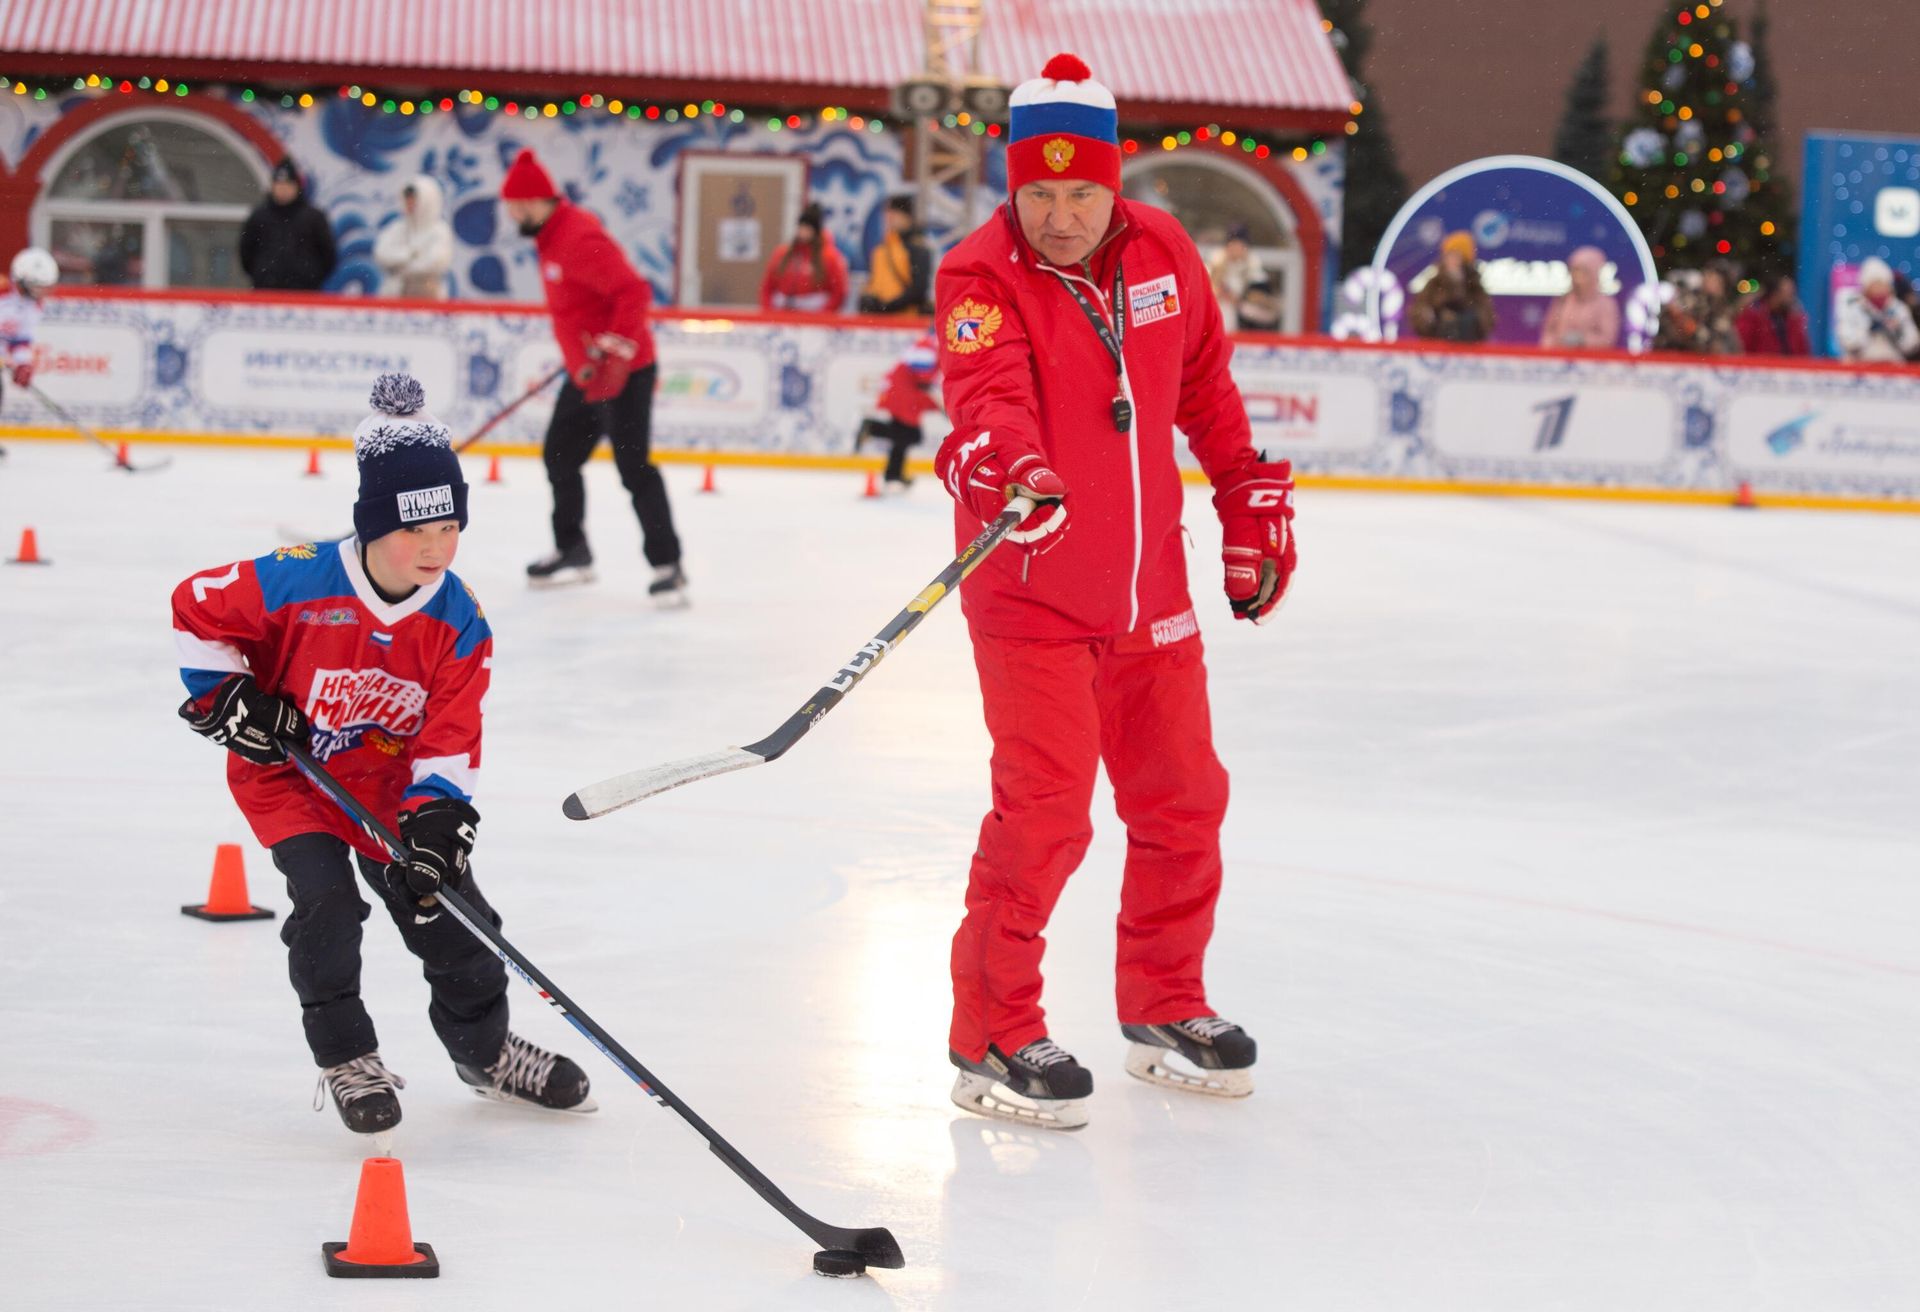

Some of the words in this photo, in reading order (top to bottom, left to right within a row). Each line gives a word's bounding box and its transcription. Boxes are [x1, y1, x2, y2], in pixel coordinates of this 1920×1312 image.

[1132, 282, 1161, 298] КРАСНАЯ
[400, 488, 451, 511] DYNAMO
[402, 503, 452, 520] HOCKEY
[824, 638, 890, 693] CCM
